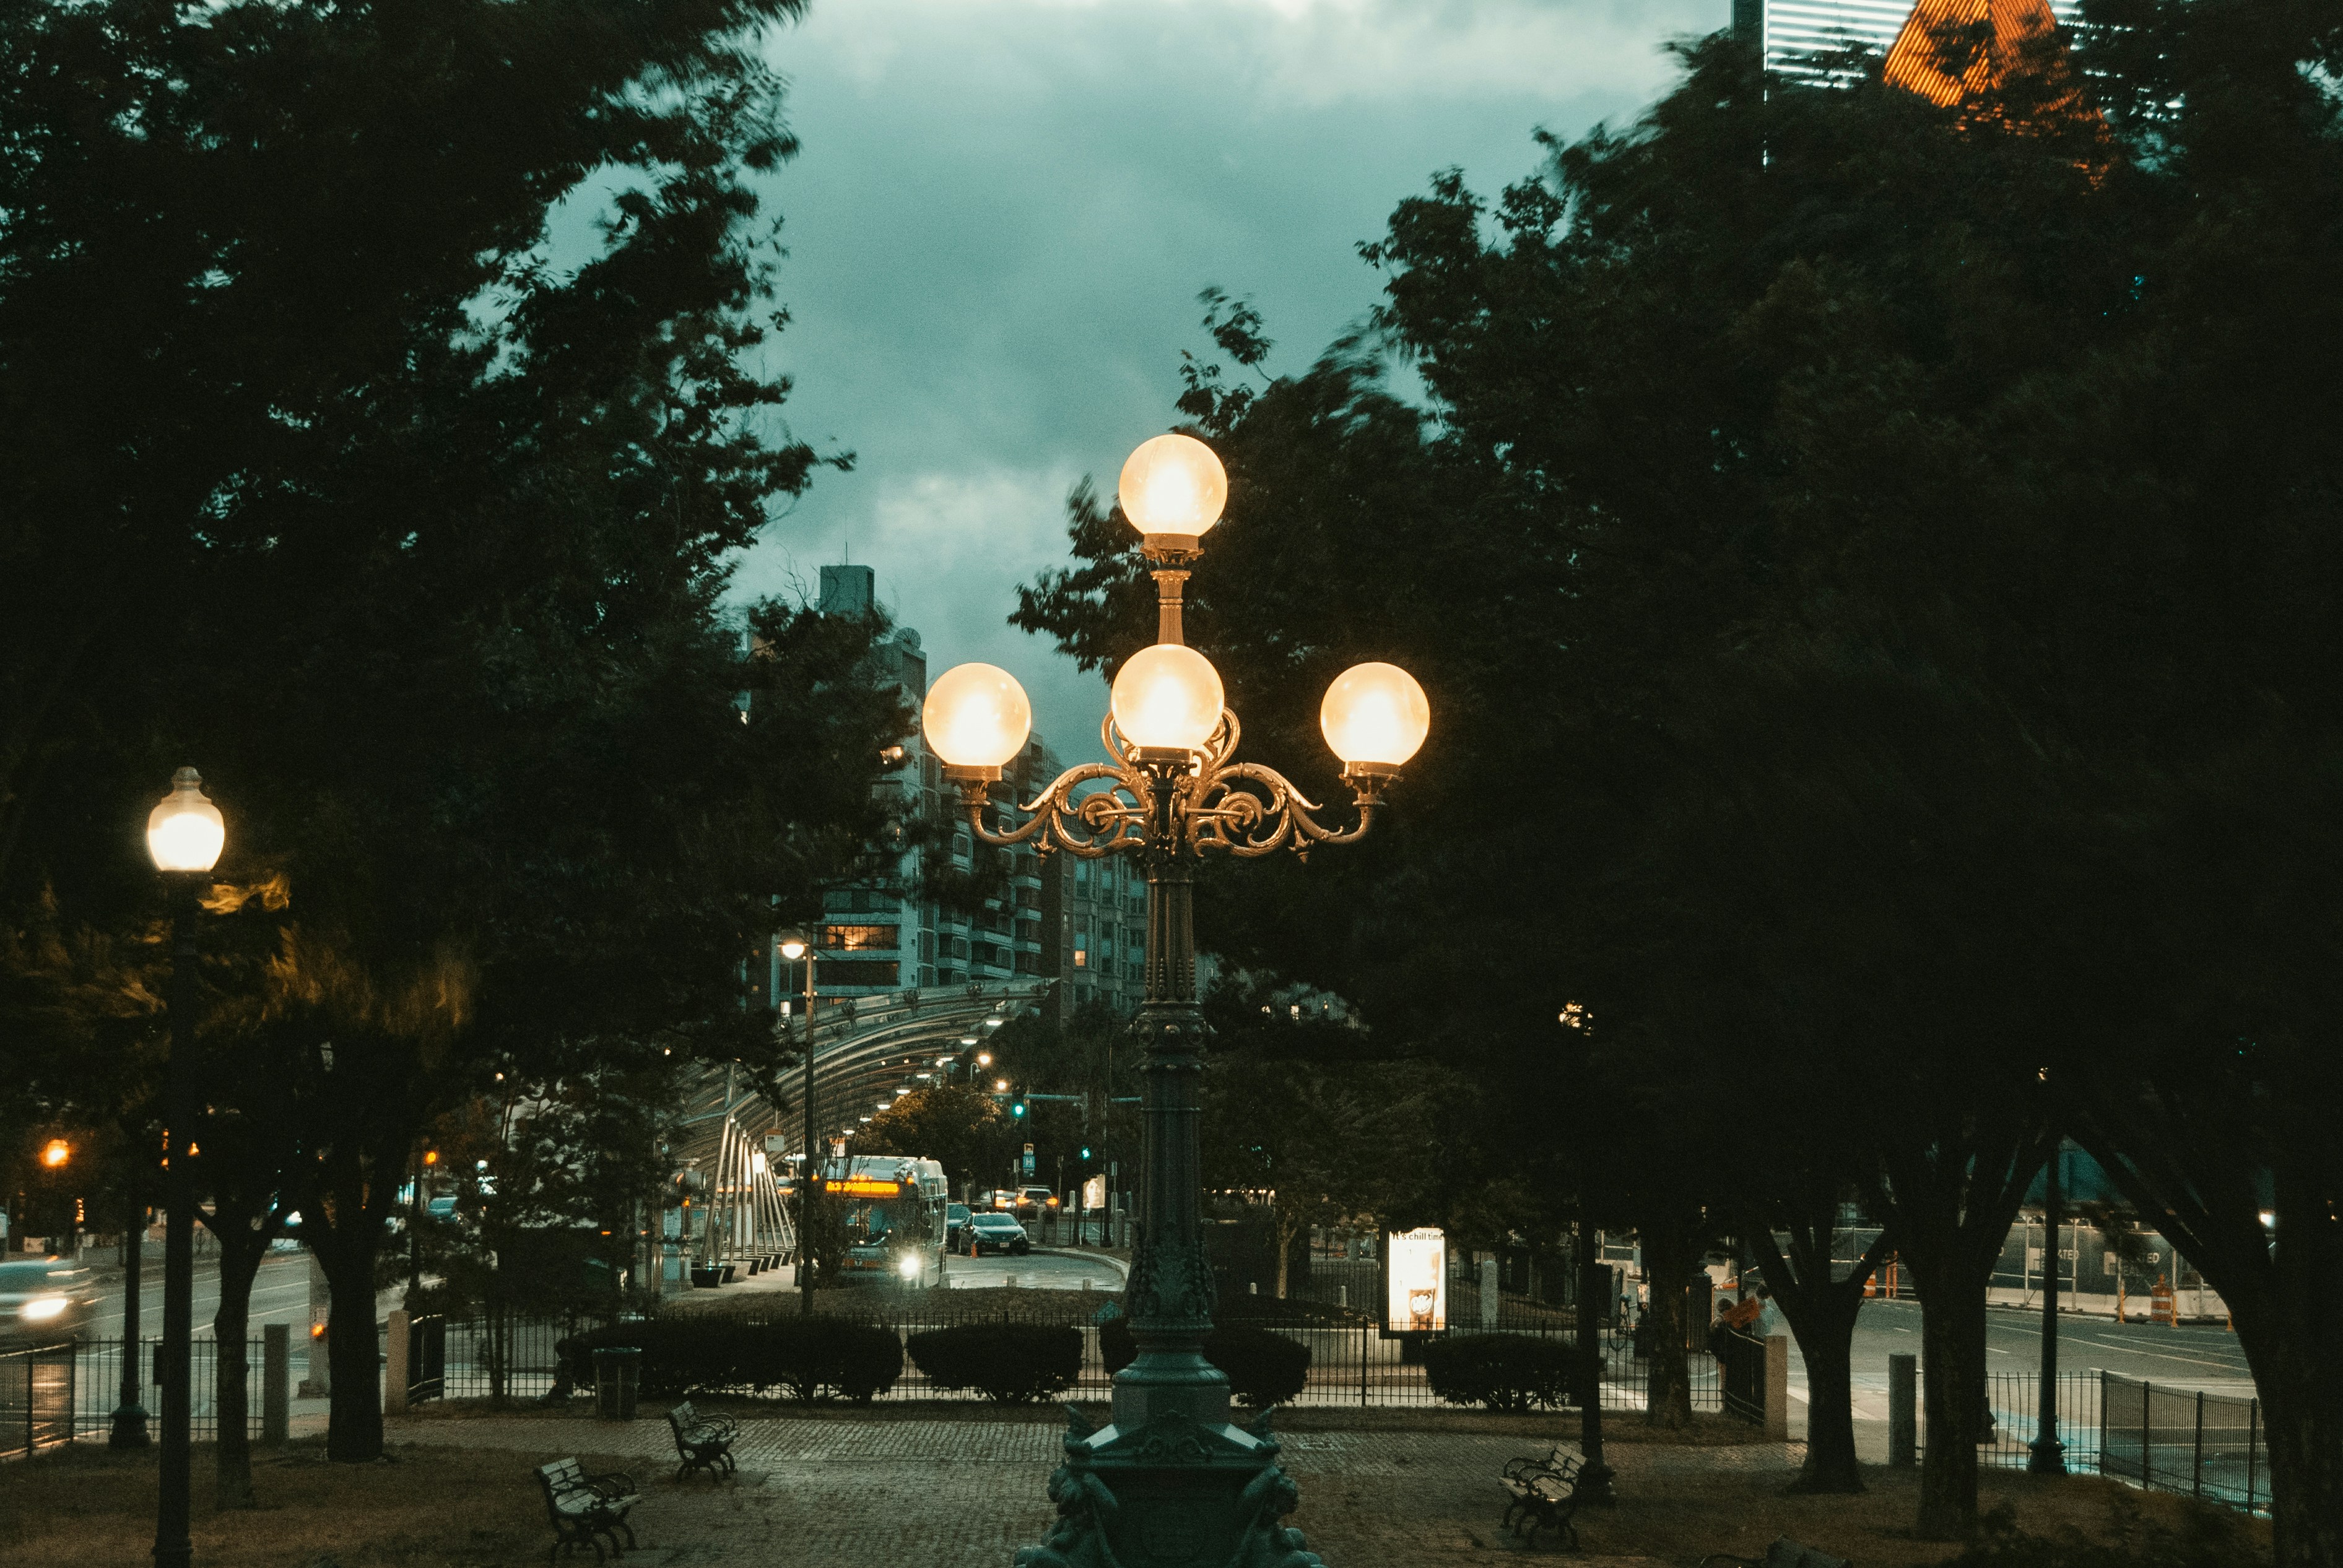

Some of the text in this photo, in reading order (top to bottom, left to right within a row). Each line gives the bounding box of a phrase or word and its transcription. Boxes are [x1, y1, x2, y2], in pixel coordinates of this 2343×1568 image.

[1025, 1157, 1033, 1166] H
[1409, 1232, 1427, 1241] chill
[1428, 1232, 1443, 1241] time
